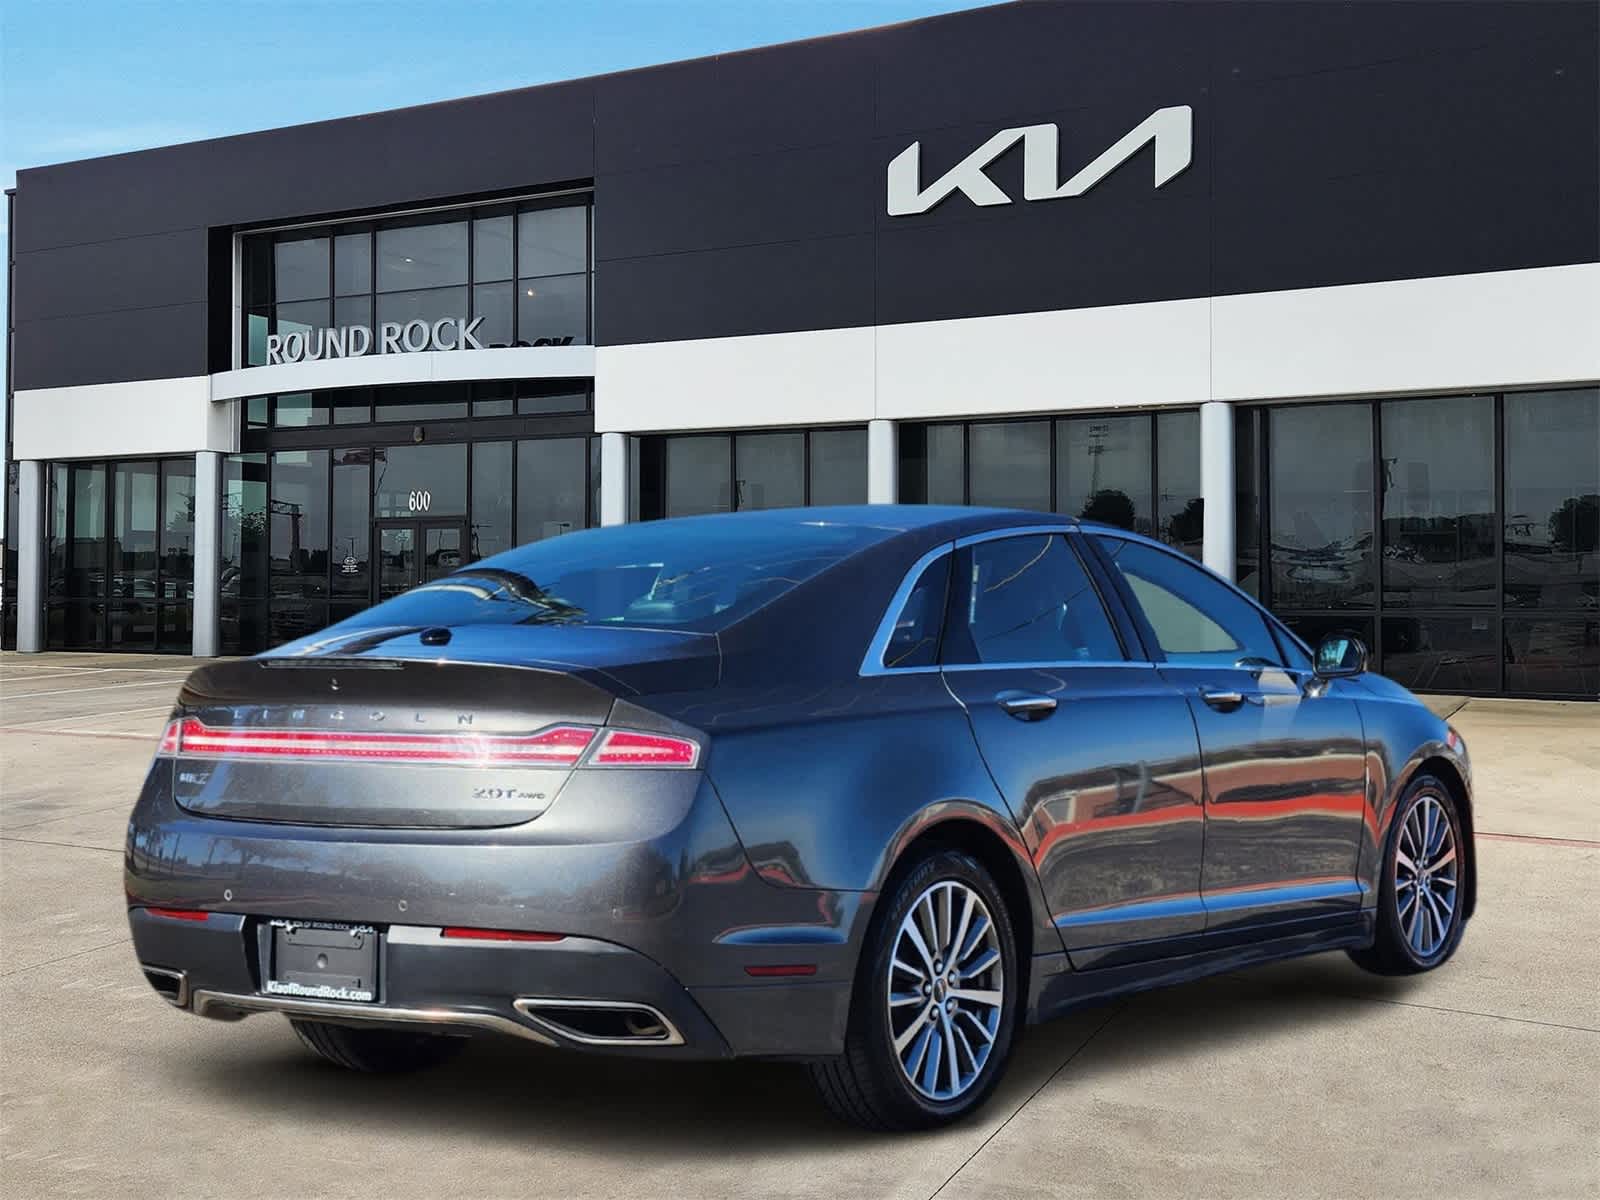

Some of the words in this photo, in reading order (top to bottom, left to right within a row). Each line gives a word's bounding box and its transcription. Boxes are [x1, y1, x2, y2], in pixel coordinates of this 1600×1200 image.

[266, 325, 371, 366] ROUND
[380, 317, 485, 354] ROCK
[409, 491, 430, 511] 600
